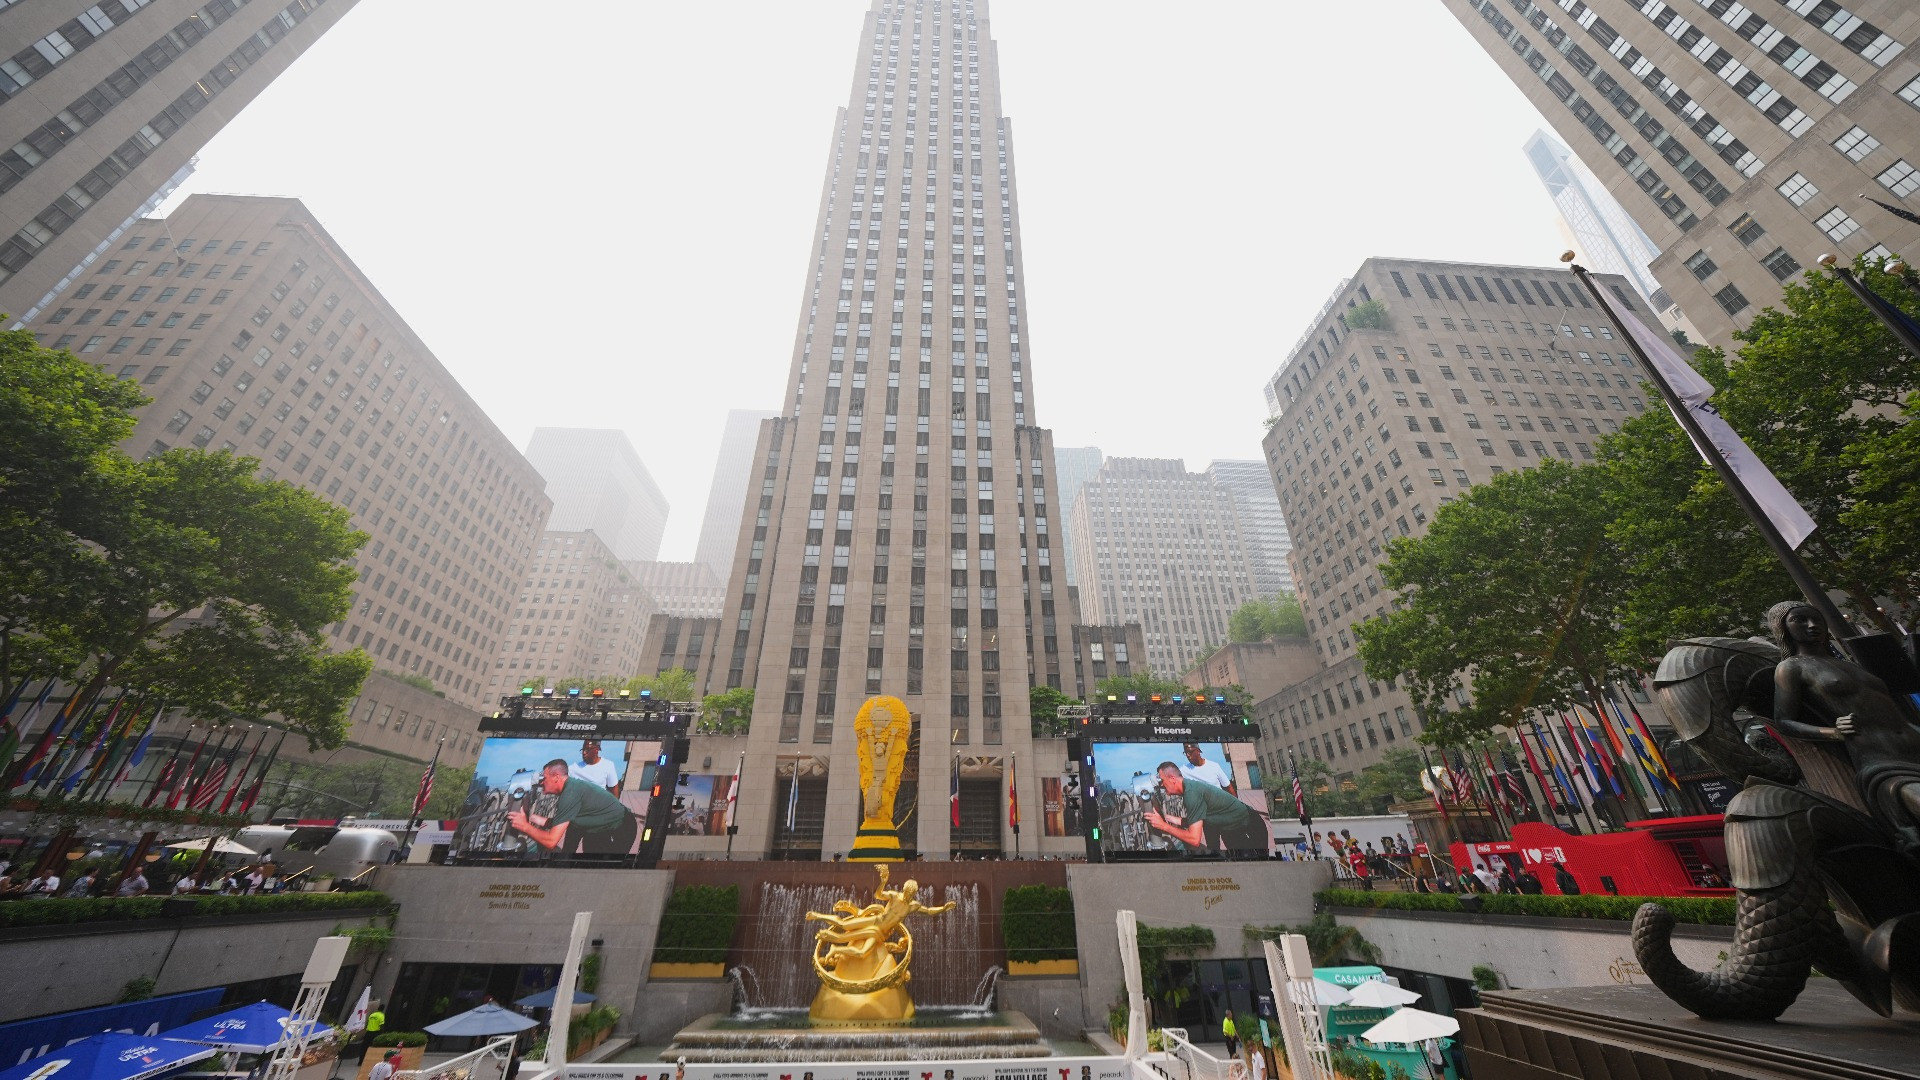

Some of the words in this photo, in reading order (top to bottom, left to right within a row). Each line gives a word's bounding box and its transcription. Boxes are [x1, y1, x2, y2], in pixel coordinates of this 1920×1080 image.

[555, 721, 597, 731] Hisense
[1154, 726, 1192, 735] Hisense
[511, 891, 545, 899] SHOPPING
[213, 1021, 247, 1030] ULTRA
[118, 1046, 160, 1062] ULTRA
